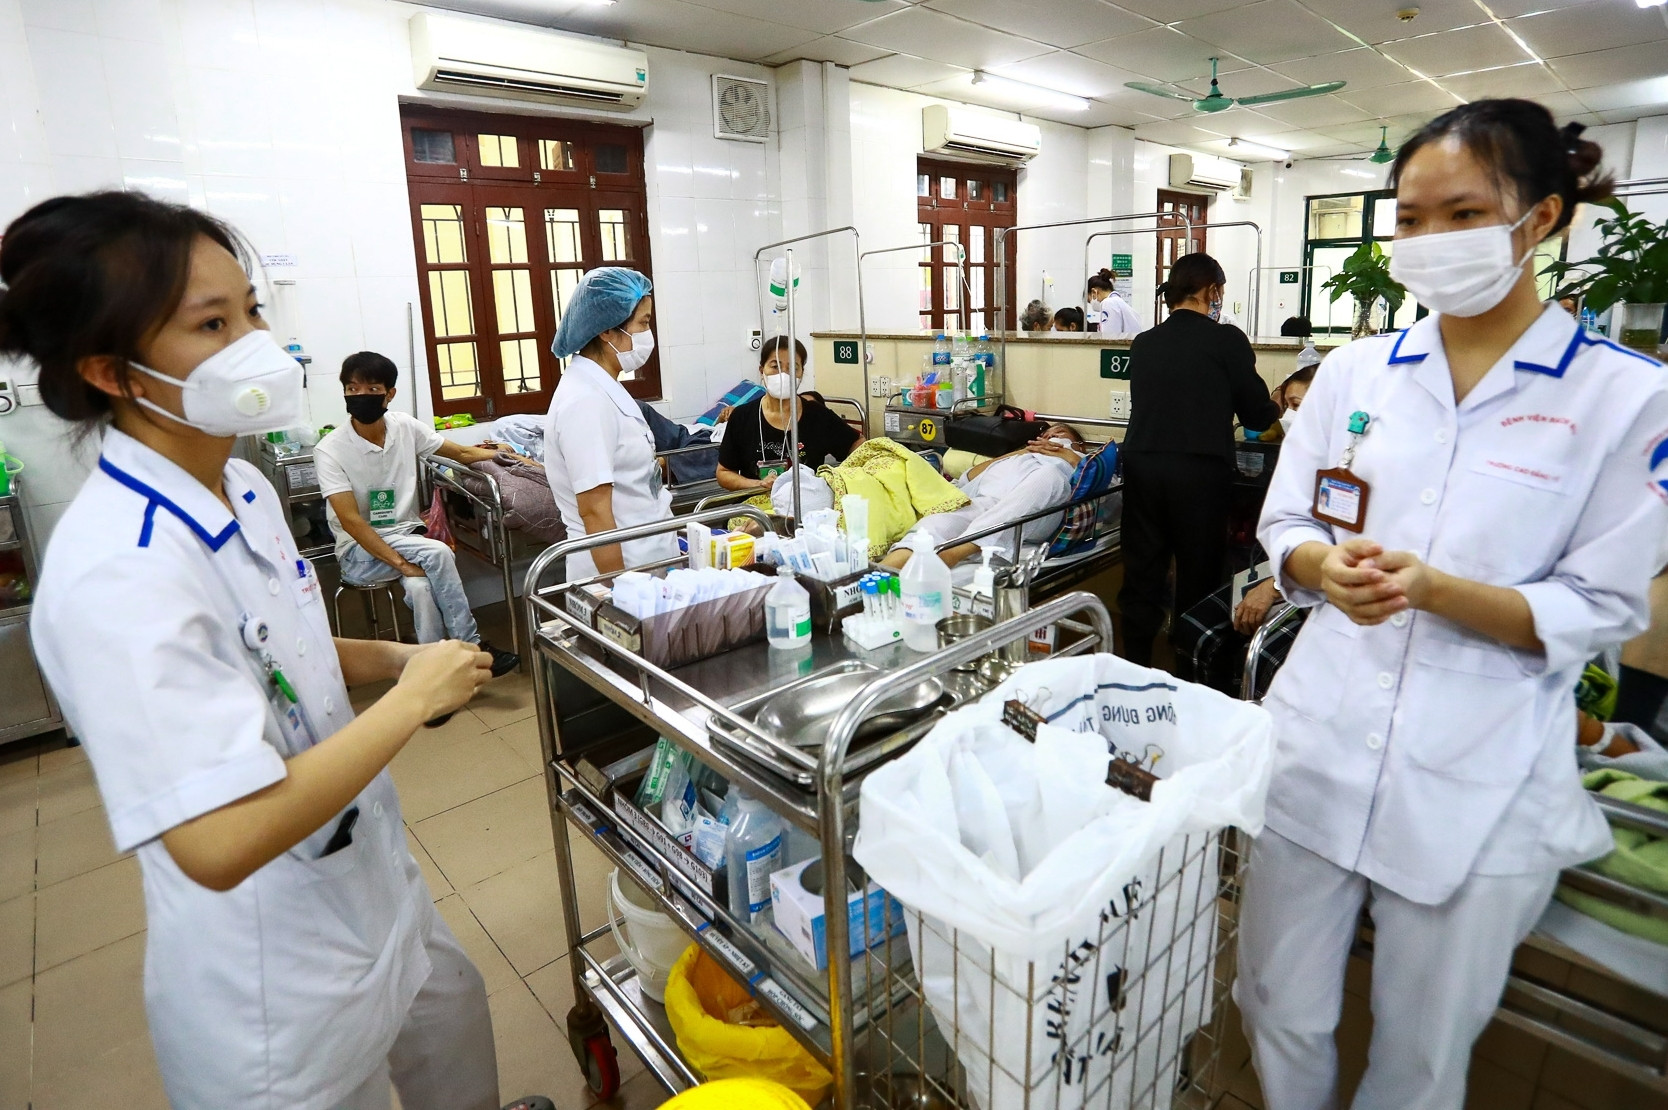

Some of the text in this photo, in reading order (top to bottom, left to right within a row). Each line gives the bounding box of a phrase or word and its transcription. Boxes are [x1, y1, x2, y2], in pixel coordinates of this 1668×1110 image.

[1284, 273, 1295, 282] 82
[839, 345, 852, 359] 88
[1110, 355, 1131, 373] 87
[921, 422, 934, 435] 87
